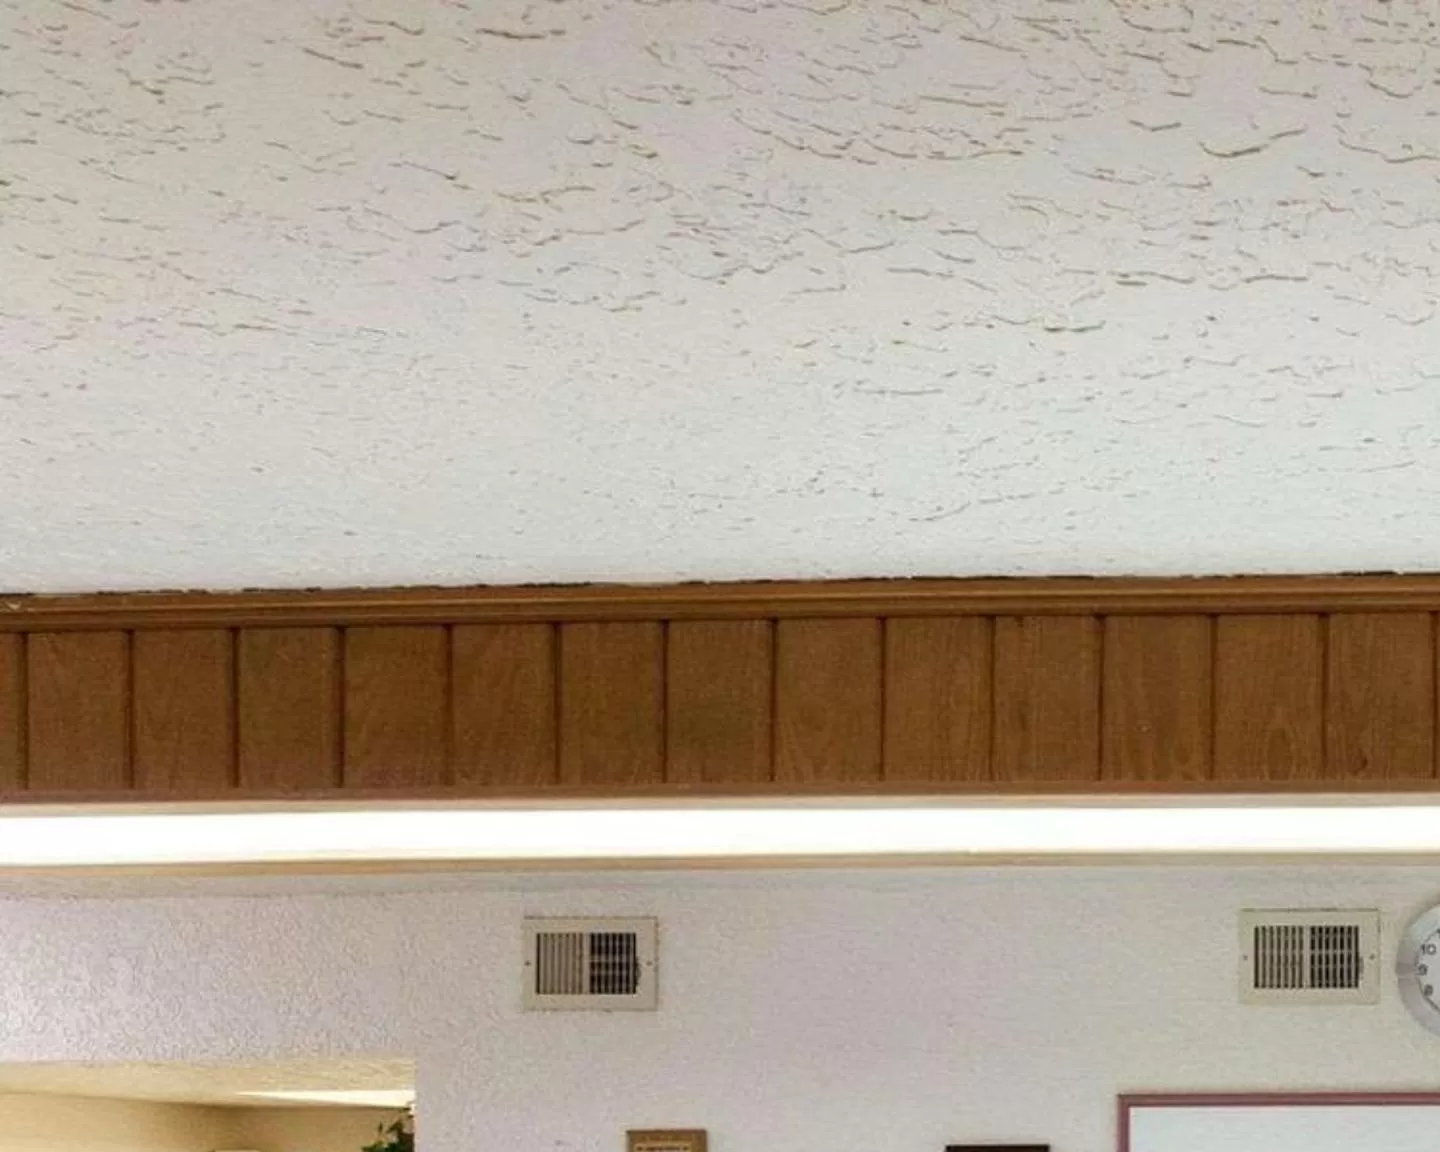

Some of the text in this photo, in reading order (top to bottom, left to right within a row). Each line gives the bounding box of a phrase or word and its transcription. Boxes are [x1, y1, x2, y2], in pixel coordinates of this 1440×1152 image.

[1421, 943, 1437, 956] 10
[1418, 963, 1428, 976] 9
[1423, 983, 1434, 997] 8
